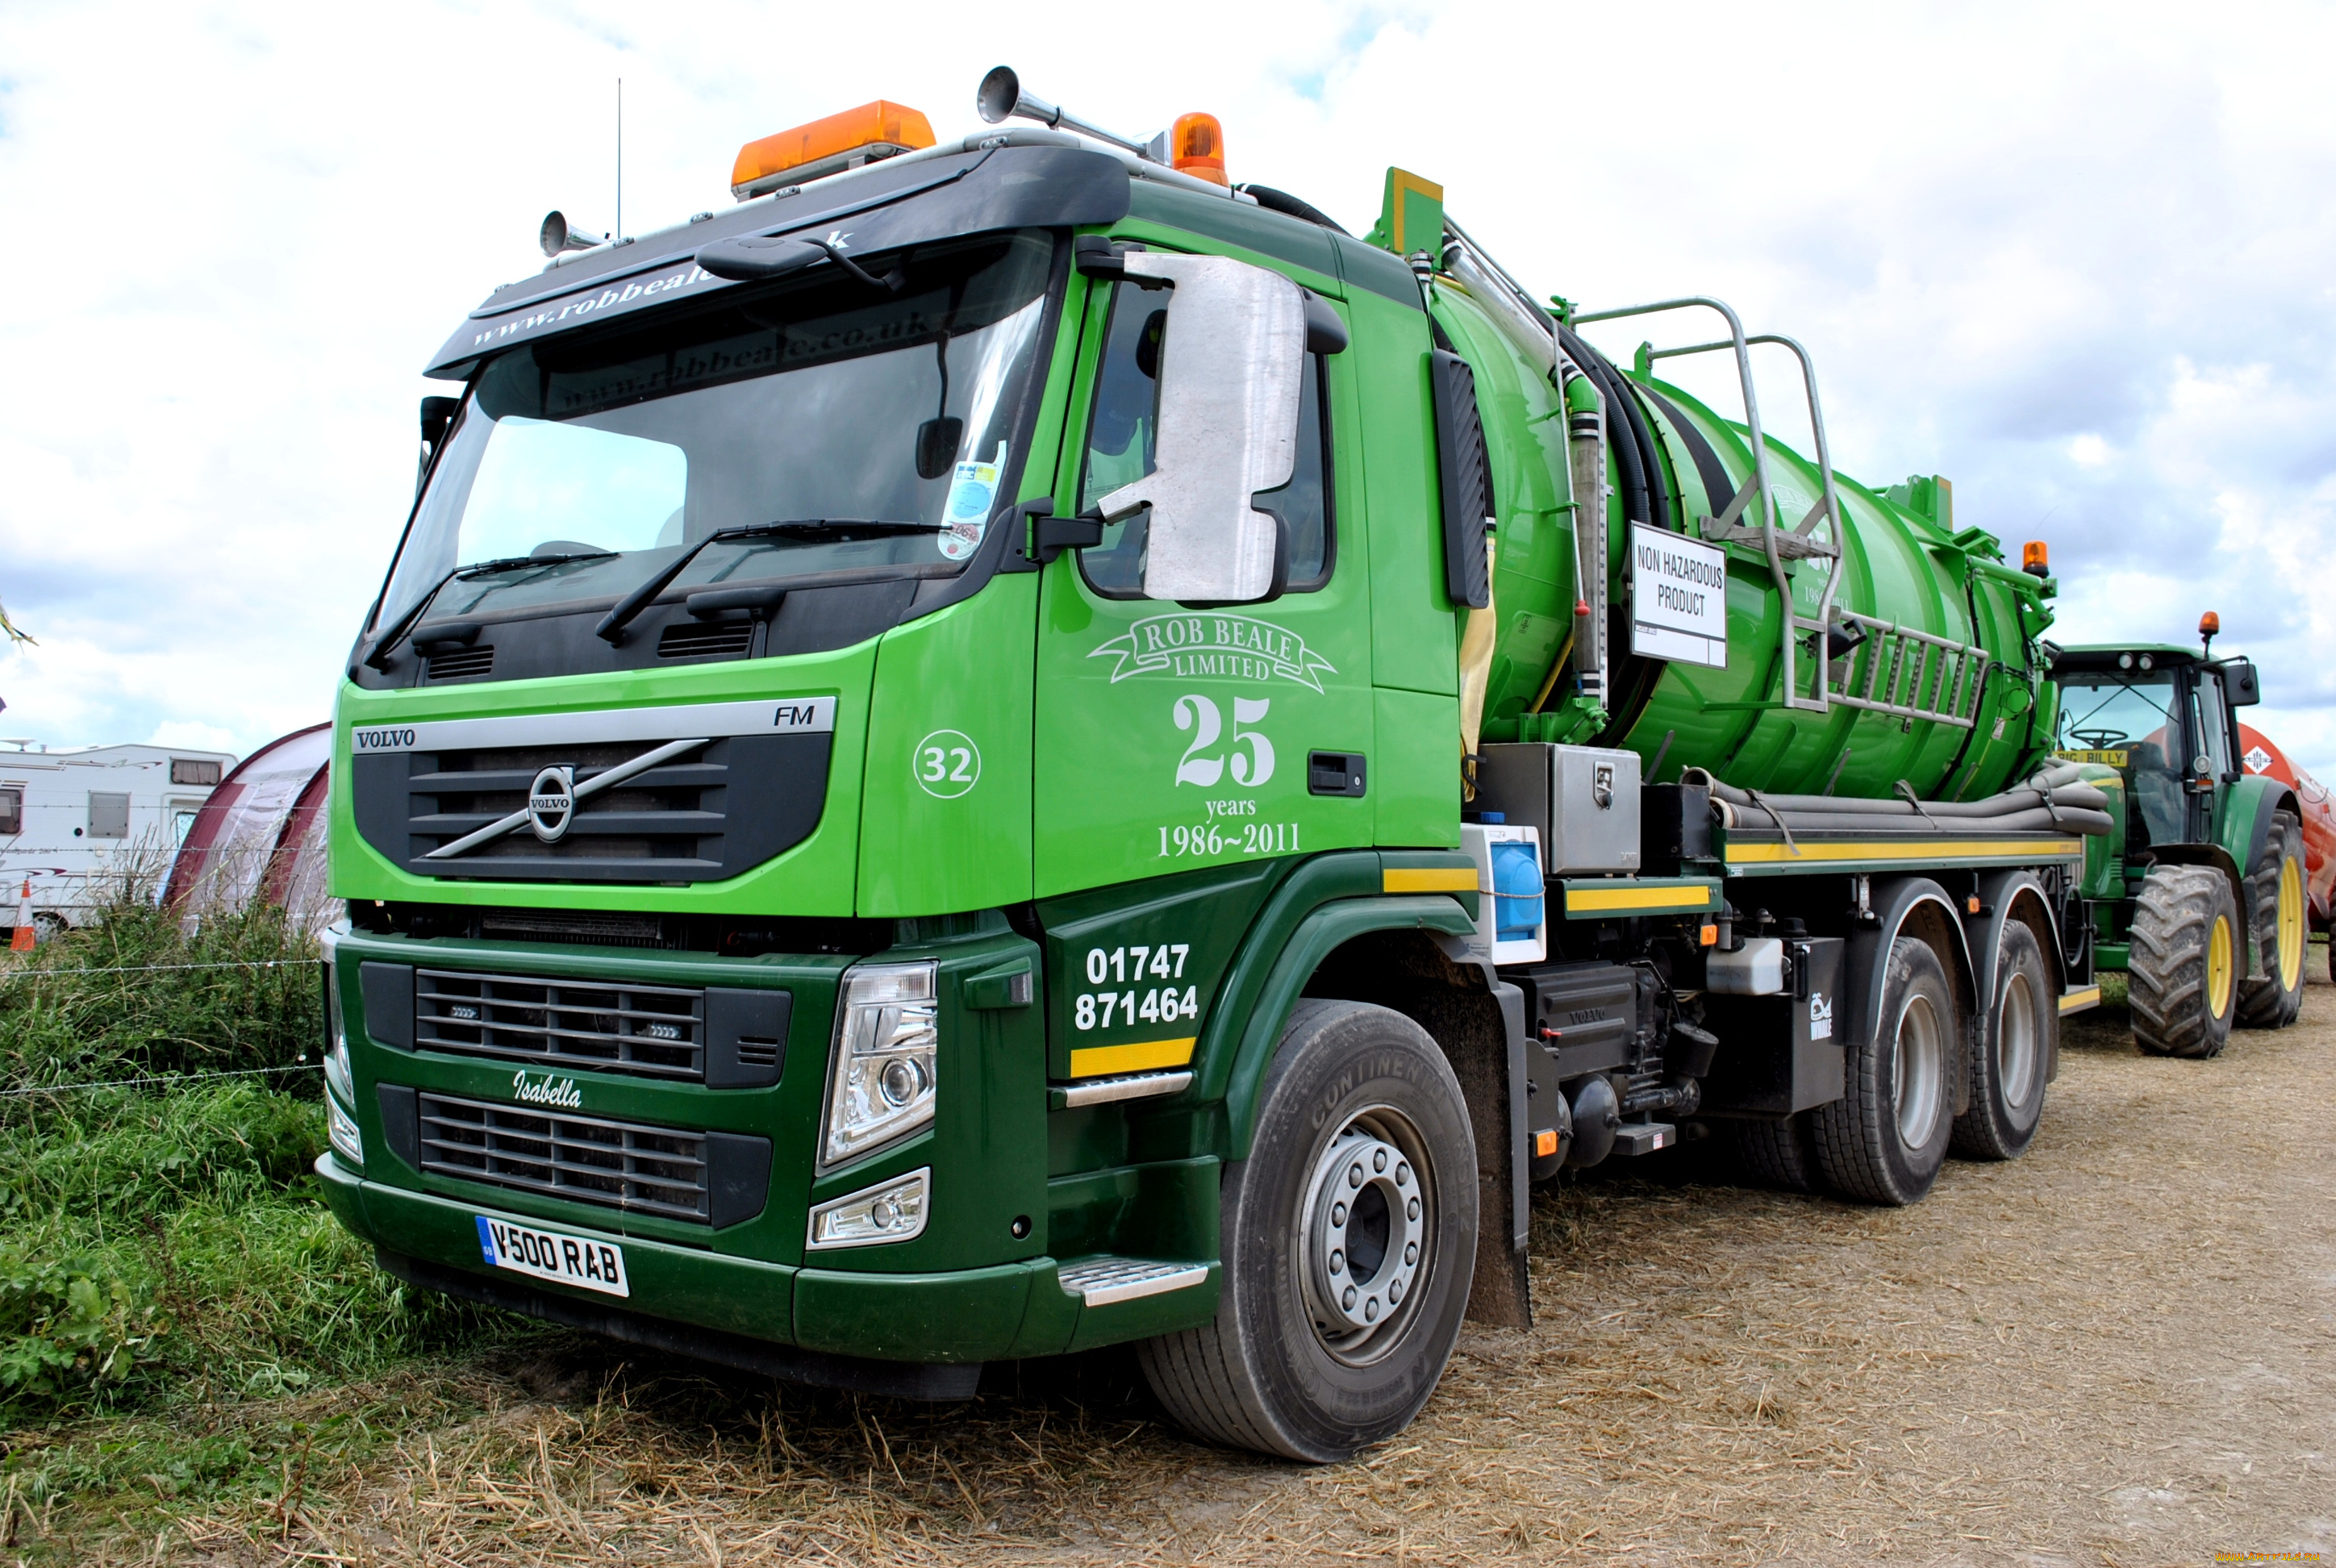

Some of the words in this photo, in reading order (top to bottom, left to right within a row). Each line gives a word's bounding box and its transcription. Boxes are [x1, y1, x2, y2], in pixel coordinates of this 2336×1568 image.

[1637, 544, 1660, 573] NON
[1663, 552, 1722, 590] HAZARDOUS
[1658, 584, 1705, 617] PRODUCT
[1143, 618, 1204, 652] ROB
[1213, 619, 1291, 661] BEALE
[1174, 654, 1270, 682] LIMITED
[774, 705, 815, 726] FM
[357, 729, 415, 749] VOLVO
[1173, 694, 1275, 787] 25
[924, 747, 972, 782] 32
[2087, 753, 2122, 764] BILLY
[531, 799, 569, 808] VOLVO
[1205, 799, 1256, 824] years
[1087, 944, 1190, 985] 01747
[1074, 985, 1198, 1031] 871464
[1811, 1018, 1832, 1040] WHALE
[513, 1070, 582, 1108] Isabella
[1311, 1049, 1450, 1130] CONTINENTAL
[484, 1245, 494, 1257] GB
[490, 1223, 558, 1271] V500
[561, 1239, 619, 1284] RAB
